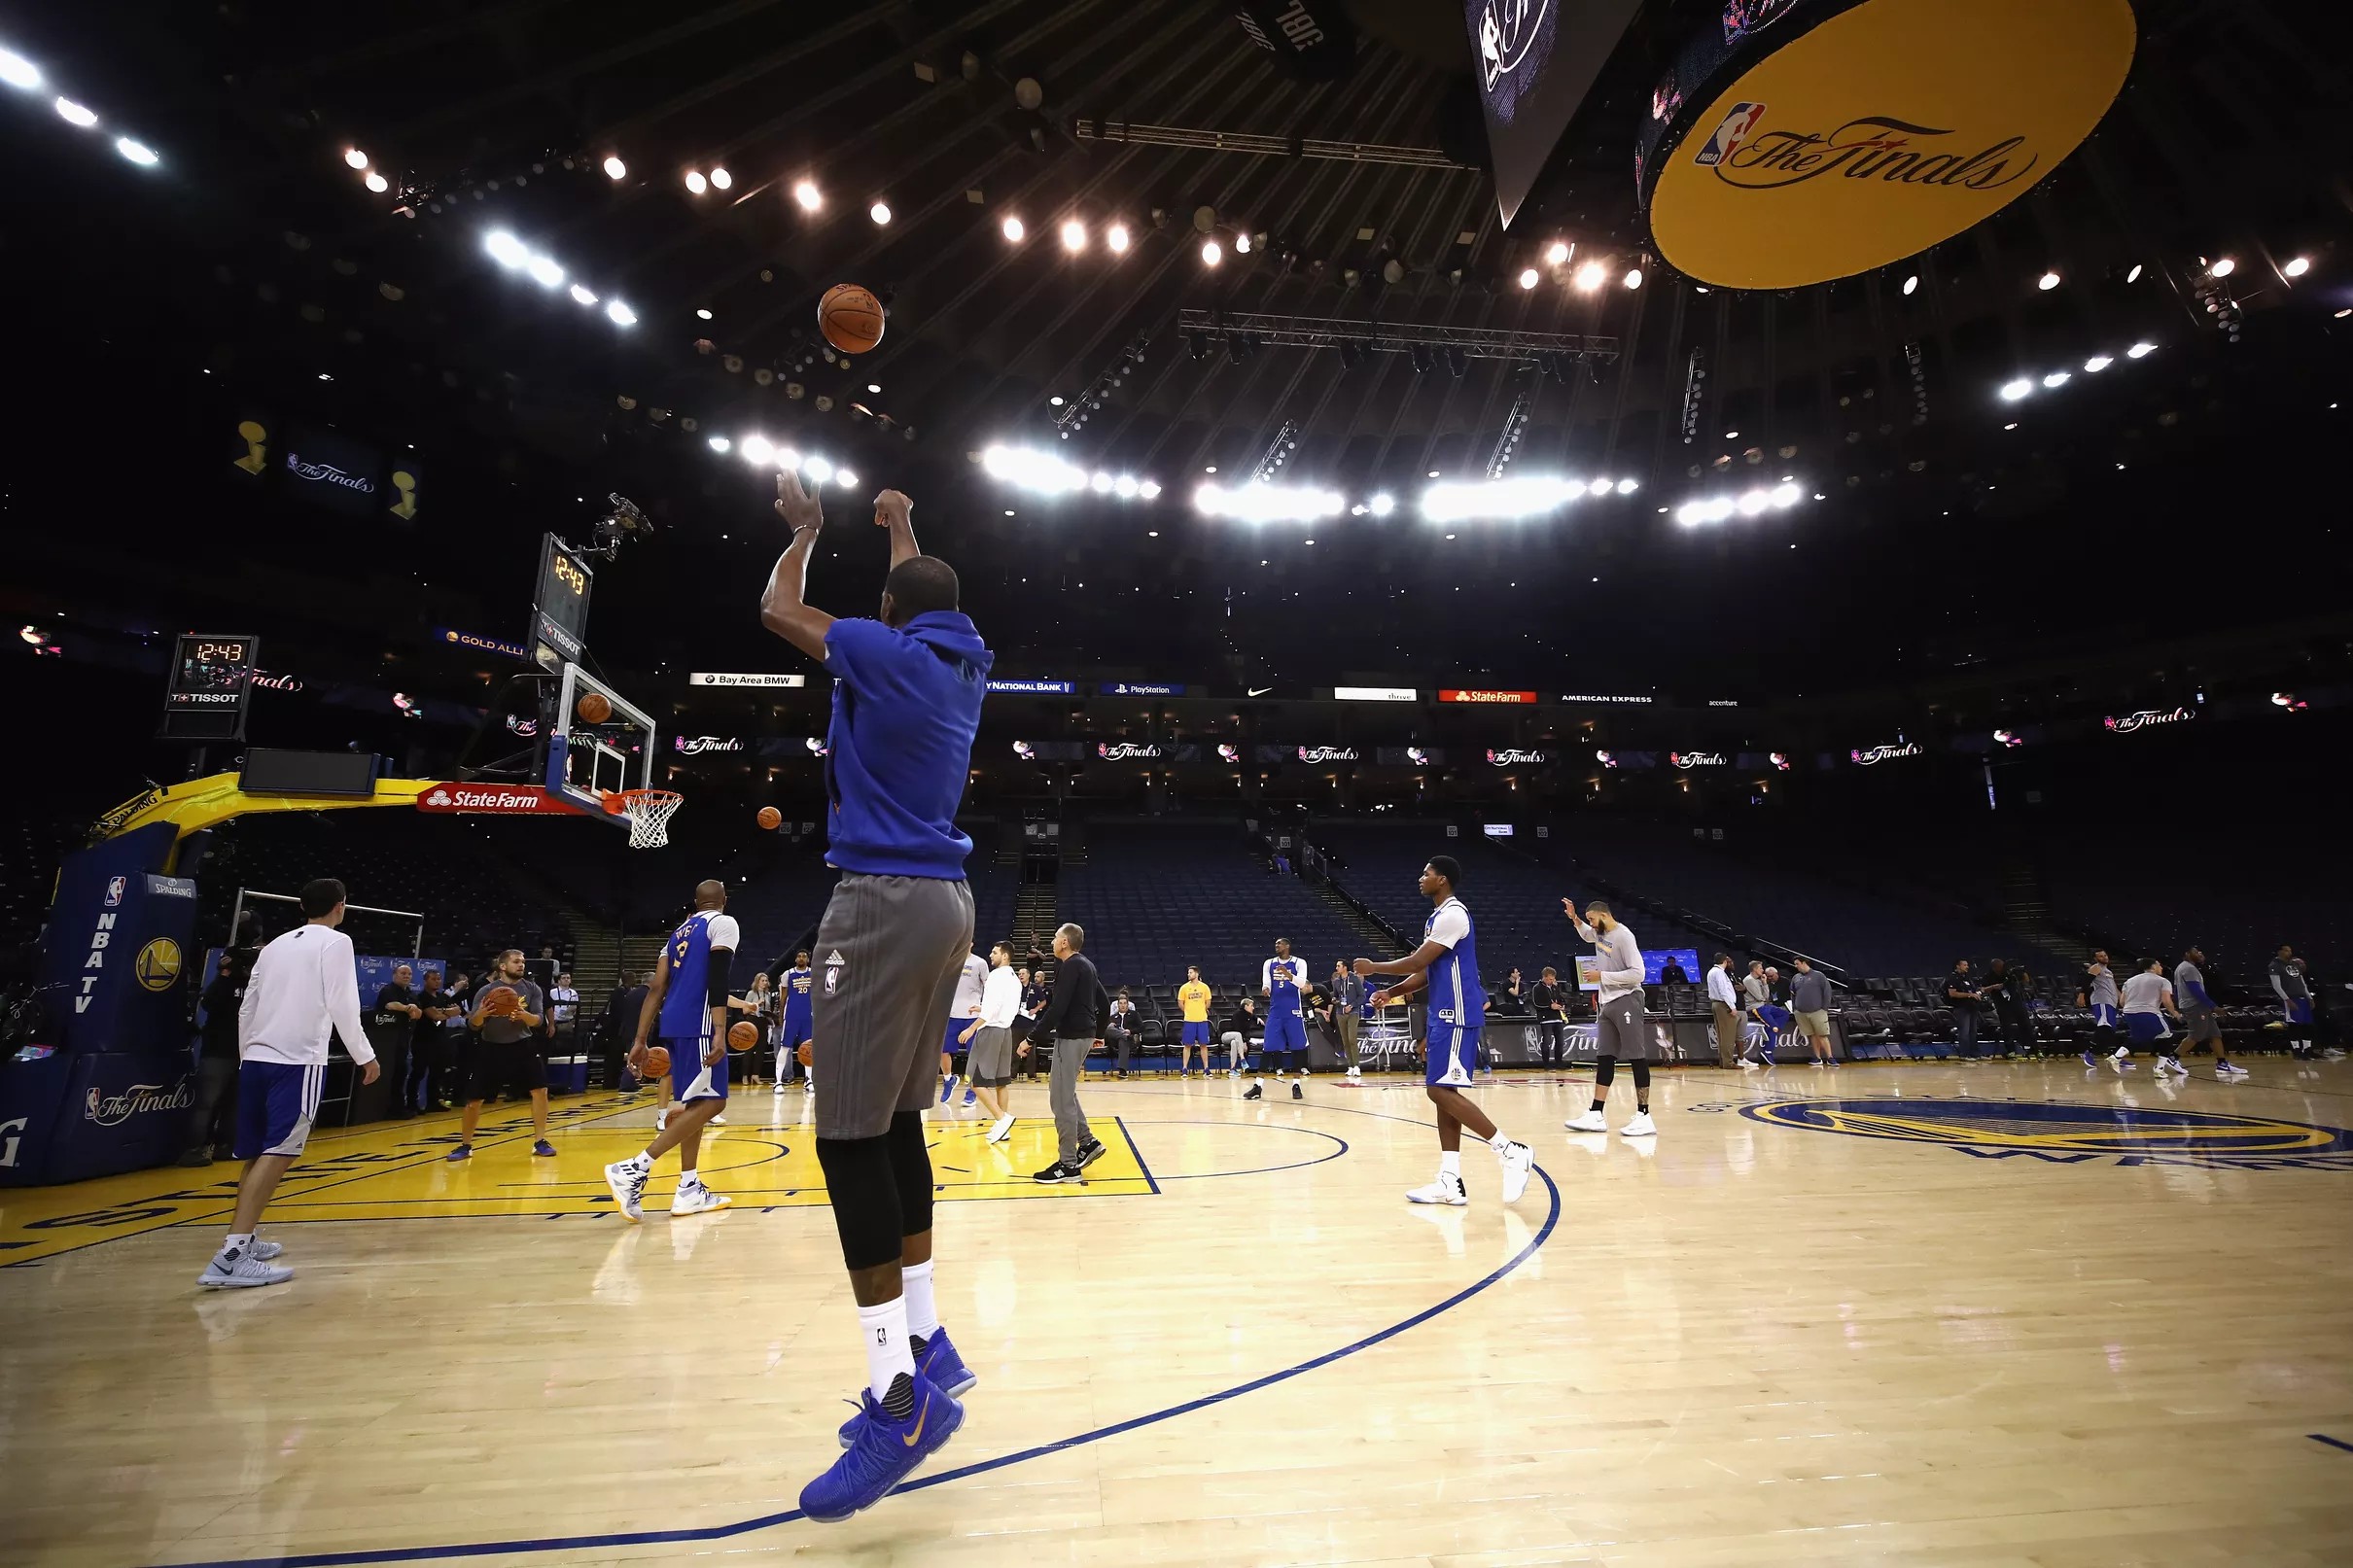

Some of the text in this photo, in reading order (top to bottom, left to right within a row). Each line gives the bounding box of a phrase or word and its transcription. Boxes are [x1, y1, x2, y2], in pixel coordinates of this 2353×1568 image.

[1731, 116, 2038, 190] The Finals
[318, 464, 374, 493] Finals
[556, 556, 584, 595] 12:43
[461, 636, 524, 656] GOLD ALLI
[554, 629, 580, 656] TISSOT
[197, 644, 242, 661] 12:43
[720, 677, 736, 685] Bay
[992, 681, 1036, 691] NATIONAL
[1036, 682, 1062, 691] BANK
[190, 693, 239, 703] TISSOT
[1131, 685, 1170, 695] PlayStation
[2131, 707, 2195, 726] Finals
[697, 735, 744, 751] Finals
[1118, 742, 1162, 758] Finals
[1873, 742, 1923, 760] Finals
[1317, 746, 1359, 761] Finals
[1505, 749, 1545, 764] Finals
[1688, 751, 1727, 766] Finals
[155, 883, 193, 898] SPALDING
[98, 1082, 195, 1117] The Finals
